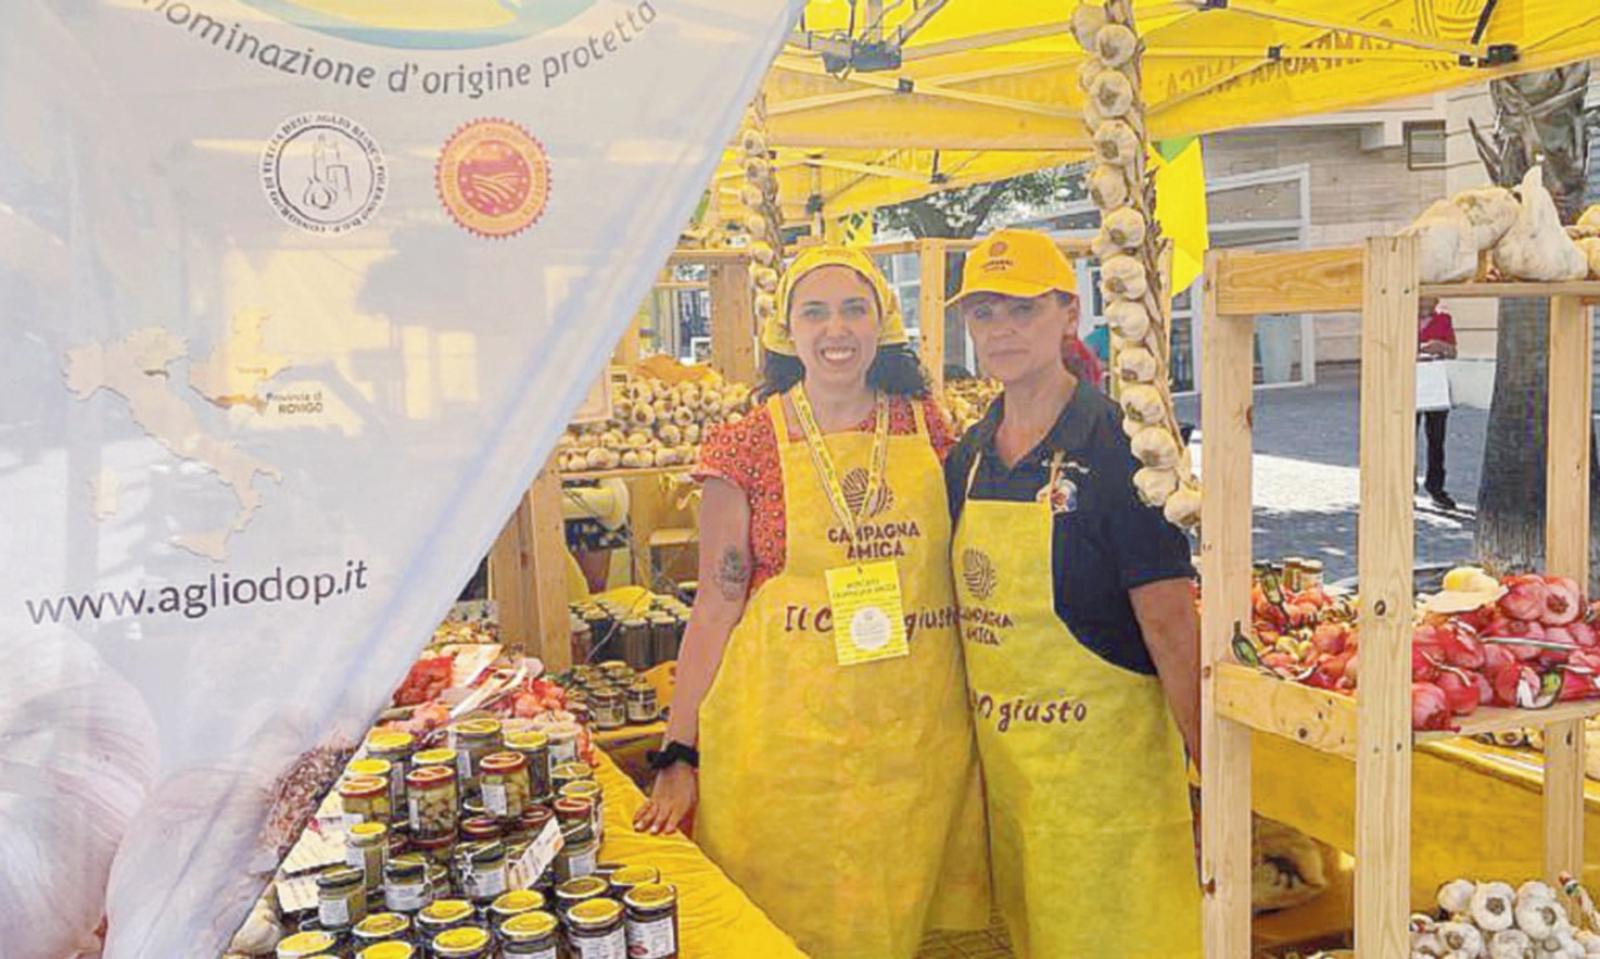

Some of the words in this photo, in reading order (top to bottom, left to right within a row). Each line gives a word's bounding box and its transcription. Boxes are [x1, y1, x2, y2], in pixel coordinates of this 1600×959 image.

[143, 0, 377, 89] ominazione
[388, 61, 531, 99] d'origine
[542, 1, 657, 87] protetta
[828, 521, 920, 543] CAMPAGNA
[847, 540, 905, 559] AMICA
[25, 560, 368, 624] www.agliodop.it
[998, 699, 1087, 733] giusto
